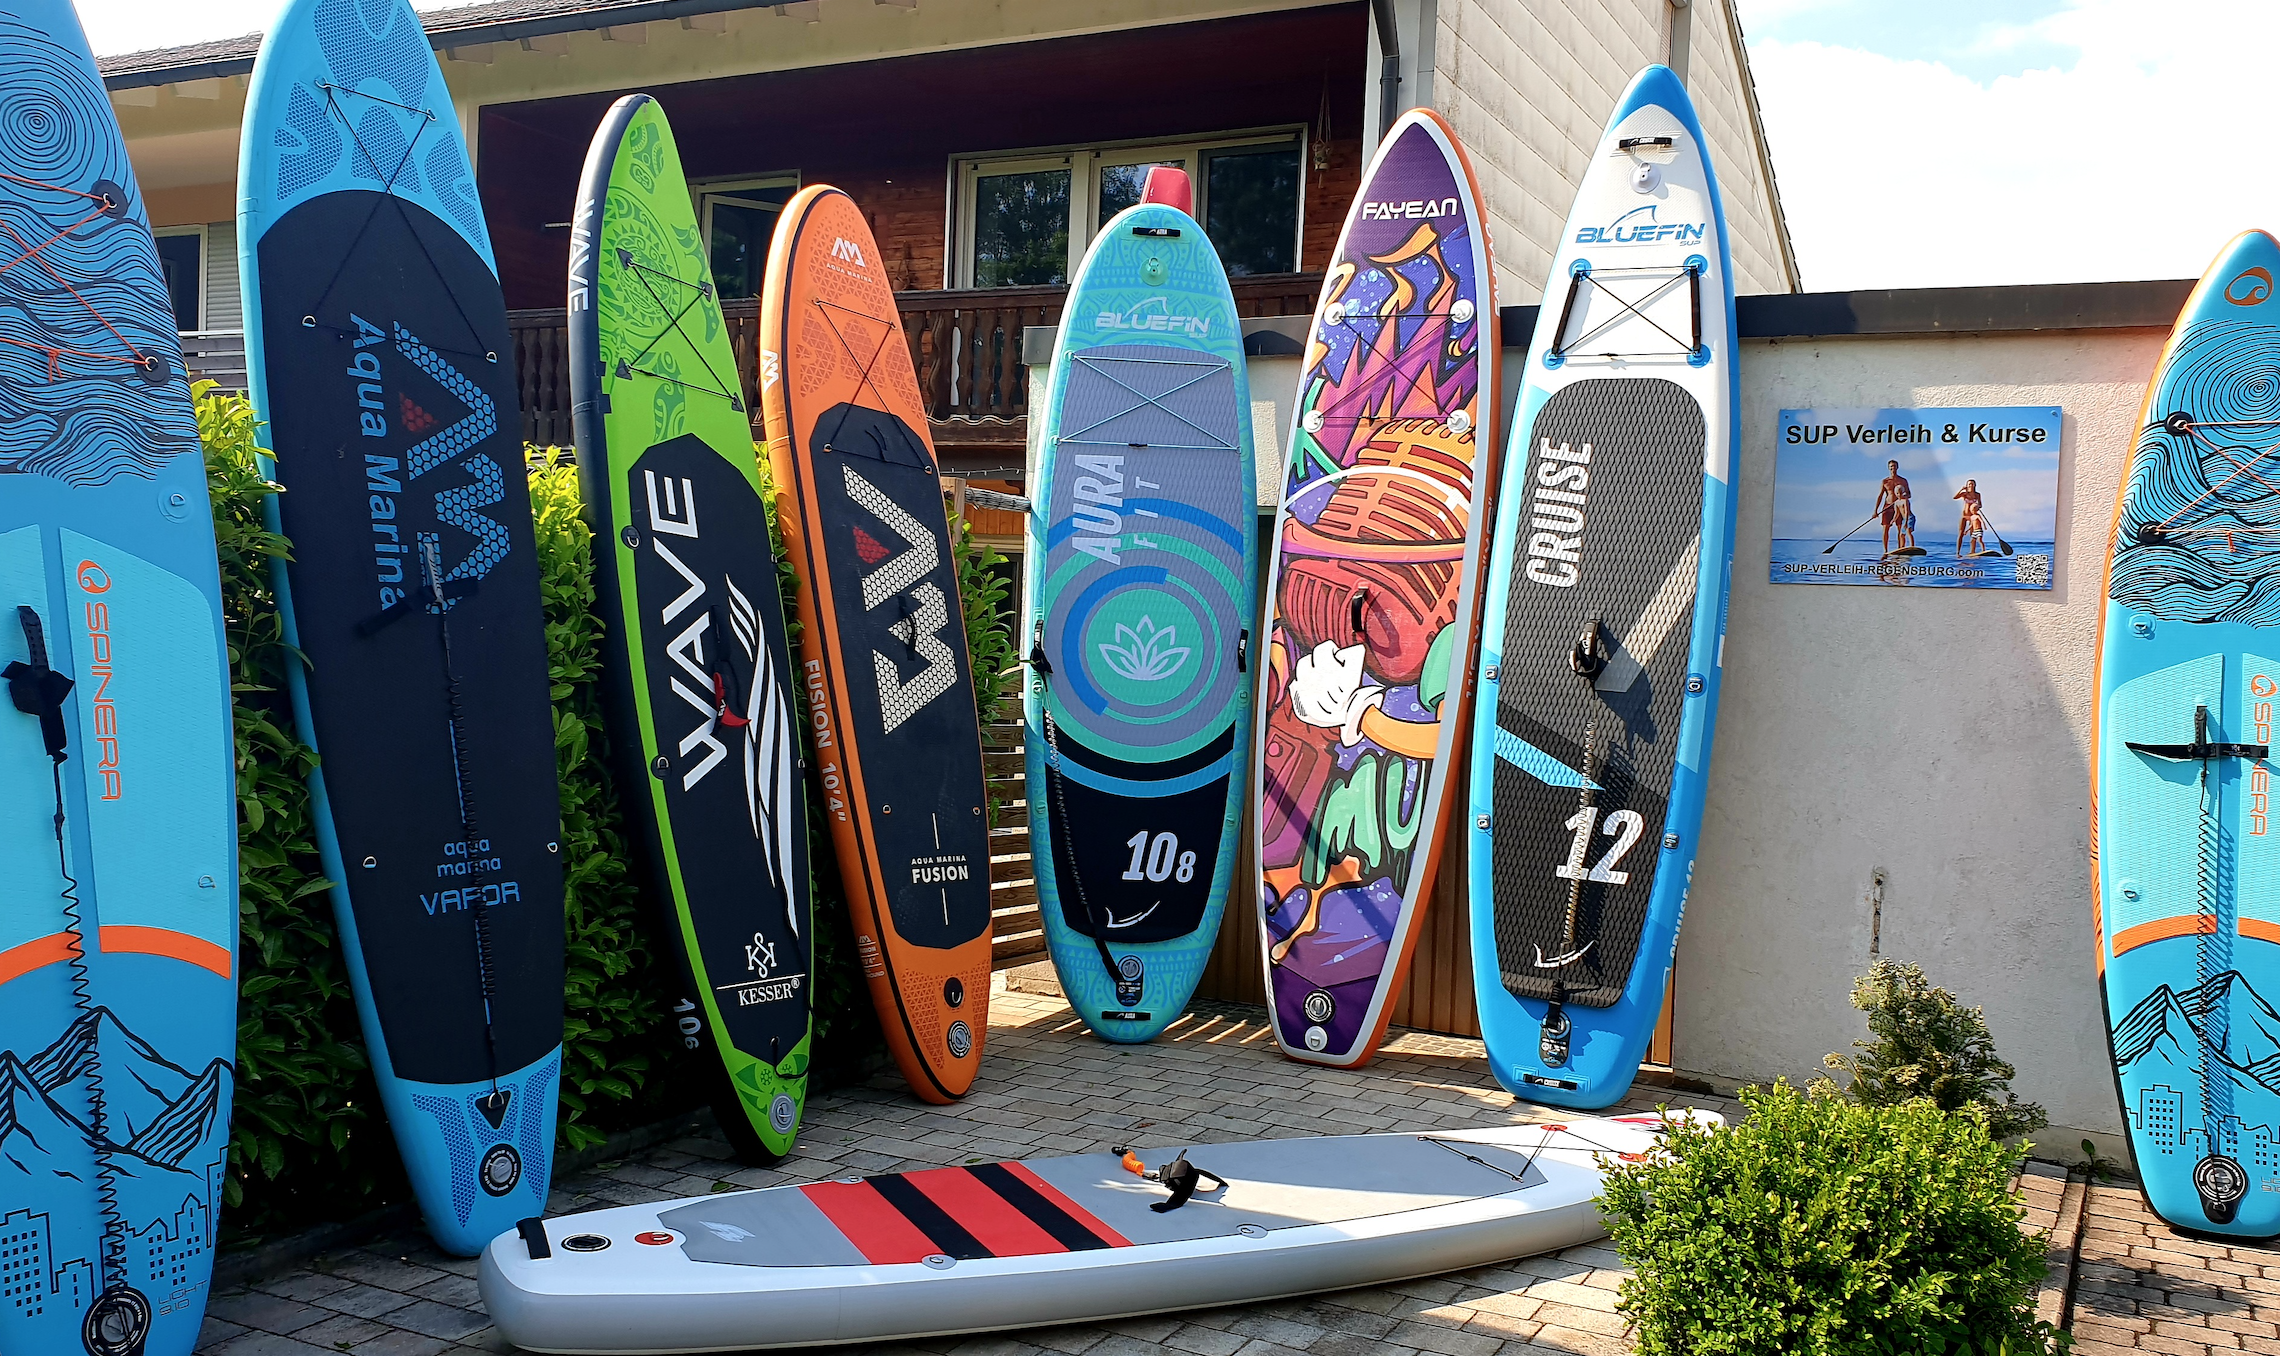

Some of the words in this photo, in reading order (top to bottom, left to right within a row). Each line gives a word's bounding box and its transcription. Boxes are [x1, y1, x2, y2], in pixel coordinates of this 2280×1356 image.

[1362, 197, 1458, 221] FAYEAN
[568, 198, 595, 318] WAVE
[1679, 239, 1702, 247] SUP
[826, 262, 846, 275] AQUA
[846, 269, 873, 284] MARINA
[346, 312, 388, 439] Aqua
[1785, 423, 1838, 445] SUP
[1846, 423, 1932, 445] Verleih
[1940, 424, 1960, 444] &
[1968, 423, 2048, 444] Kurse
[363, 452, 410, 611] Marina
[1071, 454, 1125, 566] AURA
[1525, 436, 1593, 588] CRUISE
[1783, 563, 1985, 579] SUP-VERLEIH-REGENSBURG.com
[643, 469, 729, 793] WAVE
[85, 601, 122, 801] SPINERA
[804, 659, 833, 749] FUSION
[2249, 702, 2272, 837] SPNERA
[436, 857, 502, 878] marina
[443, 838, 491, 859] aqua
[911, 857, 934, 866] AQUA
[936, 854, 967, 864] MARINA
[1555, 805, 1646, 885] 12
[419, 881, 521, 916] VAPOR
[911, 865, 969, 884] FUSION
